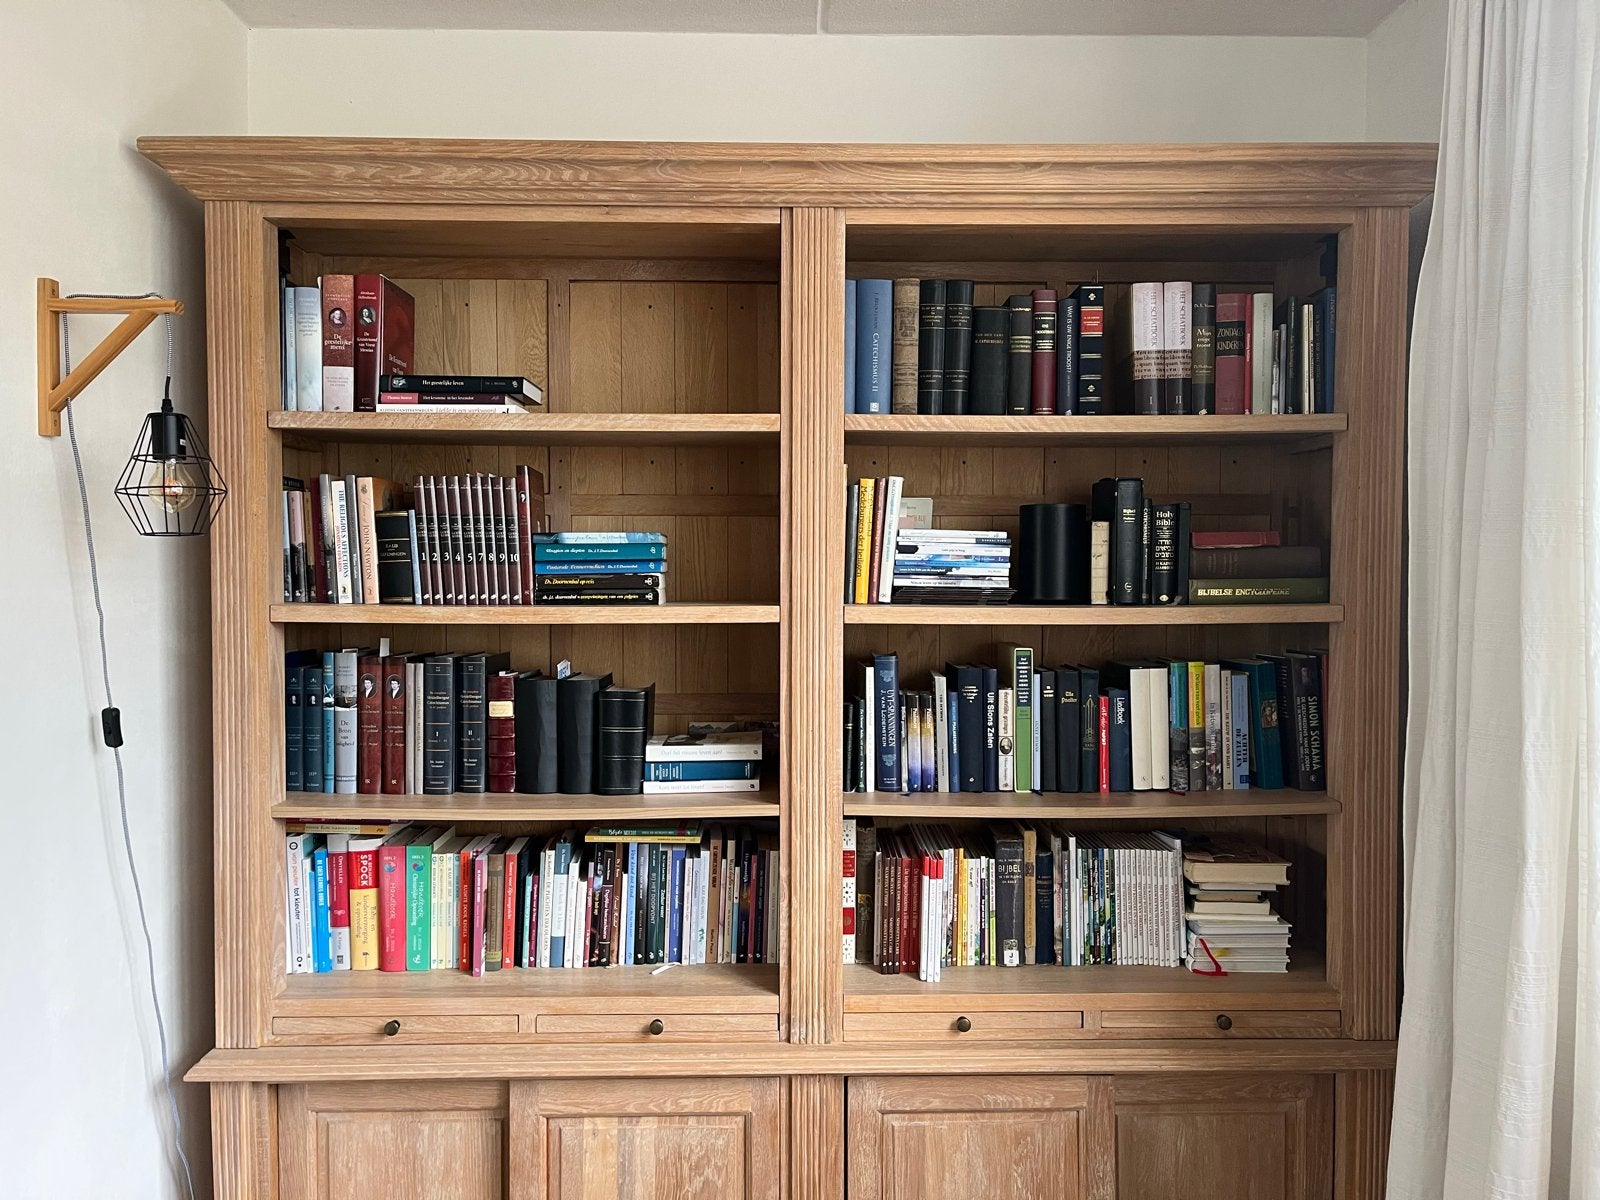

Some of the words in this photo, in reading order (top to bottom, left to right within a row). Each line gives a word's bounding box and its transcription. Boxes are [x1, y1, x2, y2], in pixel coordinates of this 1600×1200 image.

[1066, 324, 1073, 334] UW
[872, 332, 880, 384] CATECHISMUS
[857, 485, 867, 536] Medeburgers
[1156, 511, 1175, 519] Holy
[339, 504, 348, 539] RELIGIOUS
[362, 525, 371, 545] JOHN
[857, 537, 865, 550] der
[341, 540, 350, 578] AFFECTIONS
[421, 552, 426, 561] 1
[432, 553, 438, 561] 2
[444, 553, 449, 561] 3
[455, 553, 461, 561] 4
[467, 553, 473, 562] 5
[478, 553, 483, 561] 7
[488, 553, 494, 561] 8
[499, 553, 505, 562] 9
[510, 553, 519, 562] 10
[856, 548, 865, 577] heiligen
[364, 546, 373, 581] NEWTON
[1198, 588, 1233, 596] BIJBELSE
[987, 692, 995, 703] Uit
[987, 704, 995, 726] Sions
[1116, 697, 1126, 724] Liedboek
[1308, 696, 1319, 727] SIMON
[886, 689, 897, 747] UYT-SPANNINGEN
[987, 727, 995, 748] Zalen
[1235, 728, 1242, 738] DE
[1310, 730, 1322, 771] SCHAMA
[360, 854, 368, 886] SPOCK
[998, 864, 1021, 874] BIJBEL
[362, 895, 370, 944] kinderverzorging
[370, 923, 376, 931] en
